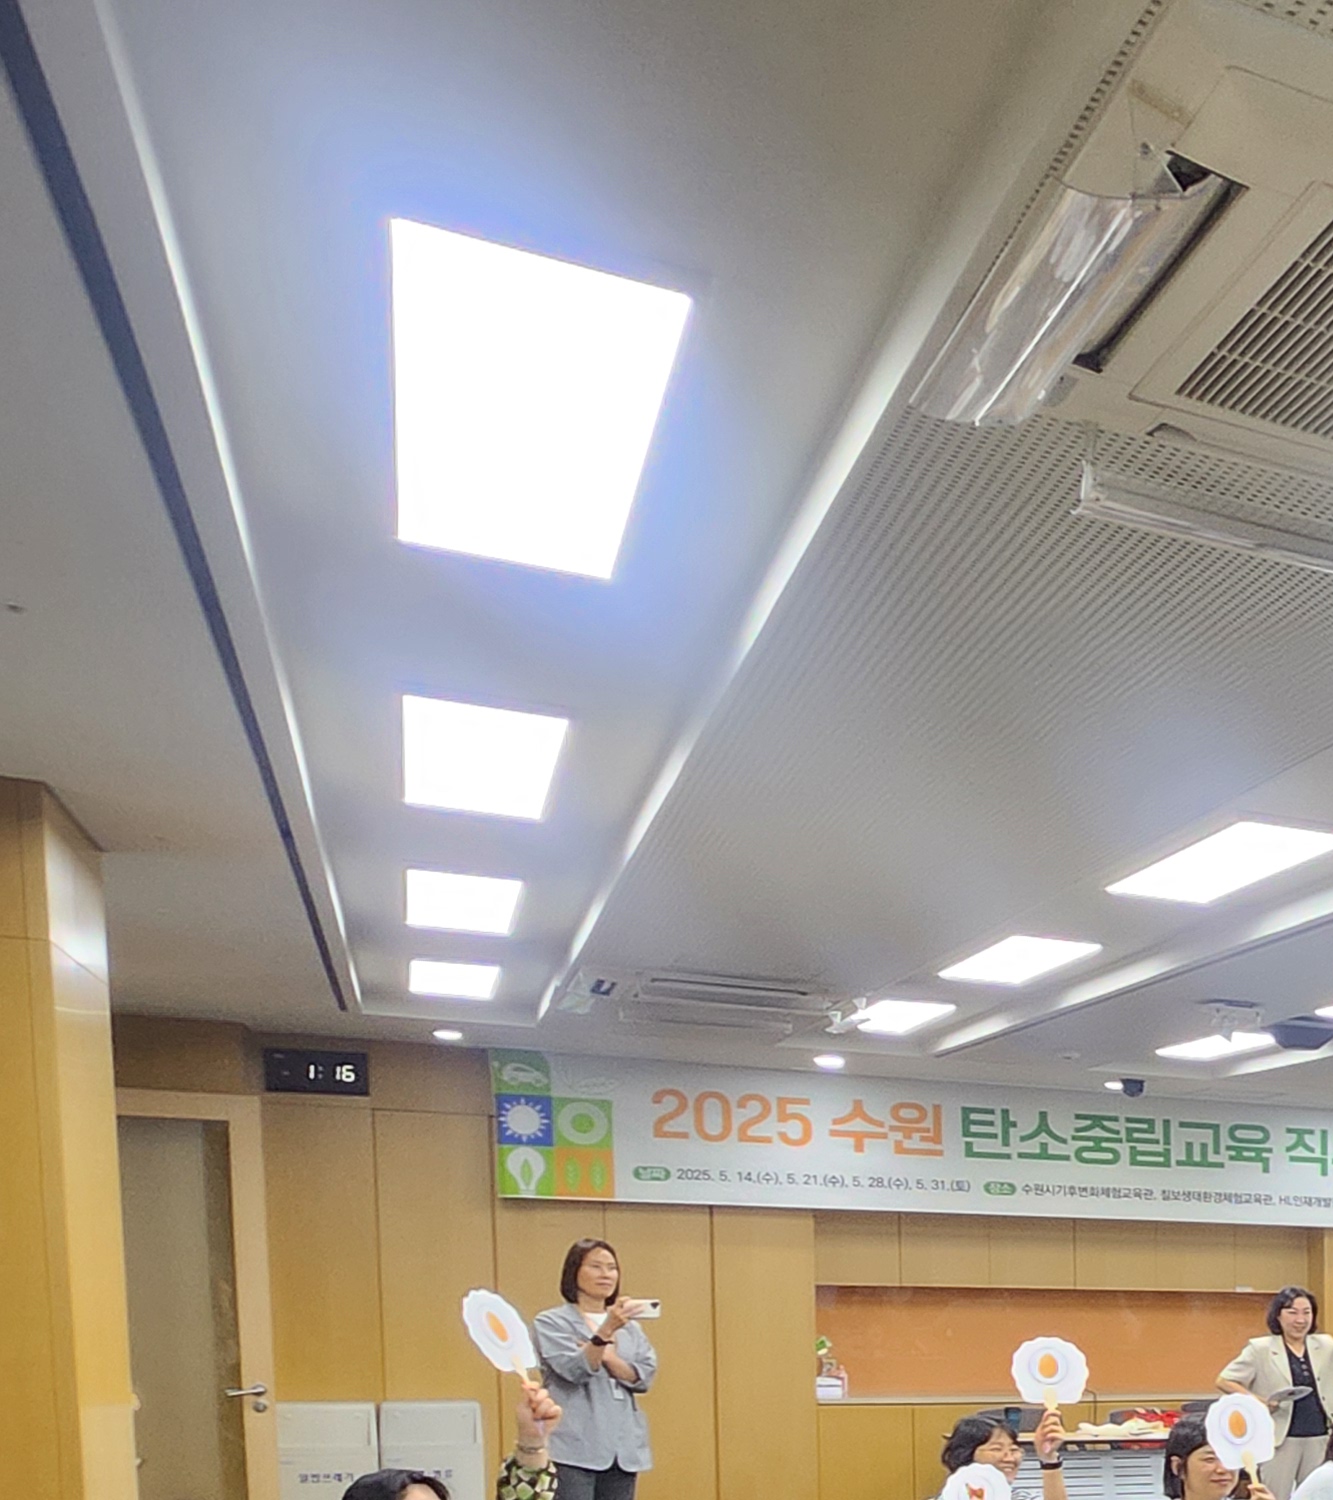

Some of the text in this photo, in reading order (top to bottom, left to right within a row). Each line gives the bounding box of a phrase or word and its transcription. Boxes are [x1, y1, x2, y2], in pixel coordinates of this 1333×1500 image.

[651, 1087, 815, 1148] 2025
[829, 1099, 945, 1158] 수원
[959, 1105, 1274, 1174] 탄소중립교육
[676, 1168, 714, 1182] 2025.
[719, 1170, 731, 1182] 5.
[787, 1172, 799, 1185] 5.
[852, 1175, 864, 1188] 5.
[916, 1178, 928, 1191] 5.
